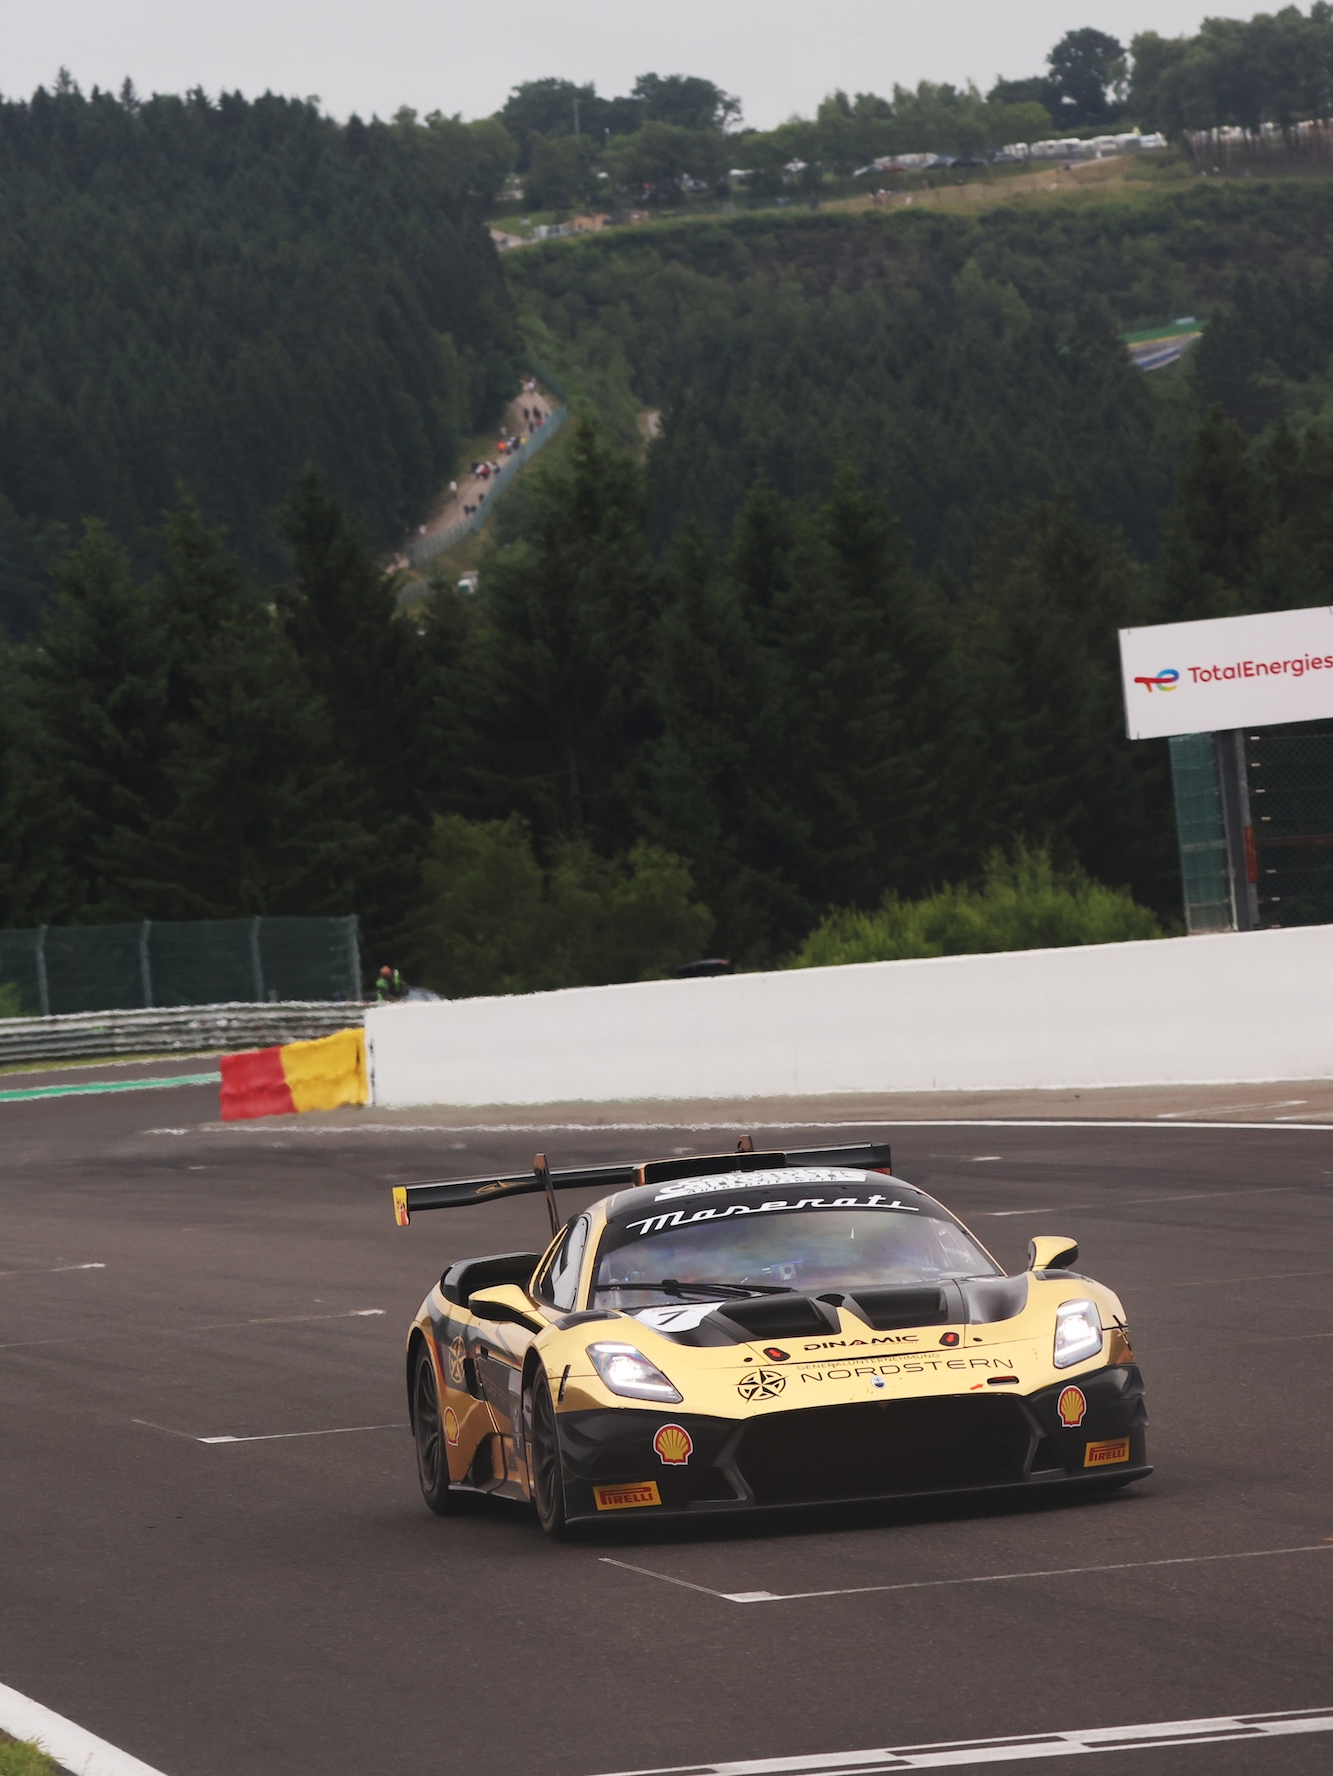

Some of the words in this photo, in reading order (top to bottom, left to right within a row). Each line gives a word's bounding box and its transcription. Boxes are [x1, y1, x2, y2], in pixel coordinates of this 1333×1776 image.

[1187, 653, 1333, 683] TotalEnergies
[626, 1195, 920, 1236] Maserati
[657, 1309, 689, 1326] 7
[803, 1335, 919, 1351] DINAMIC
[797, 1353, 940, 1371] GENERALUNTERNEHMUNG
[800, 1358, 1014, 1383] NORDSTERN
[1088, 1442, 1127, 1462] PIRELLI
[599, 1486, 654, 1506] PIRELLI
